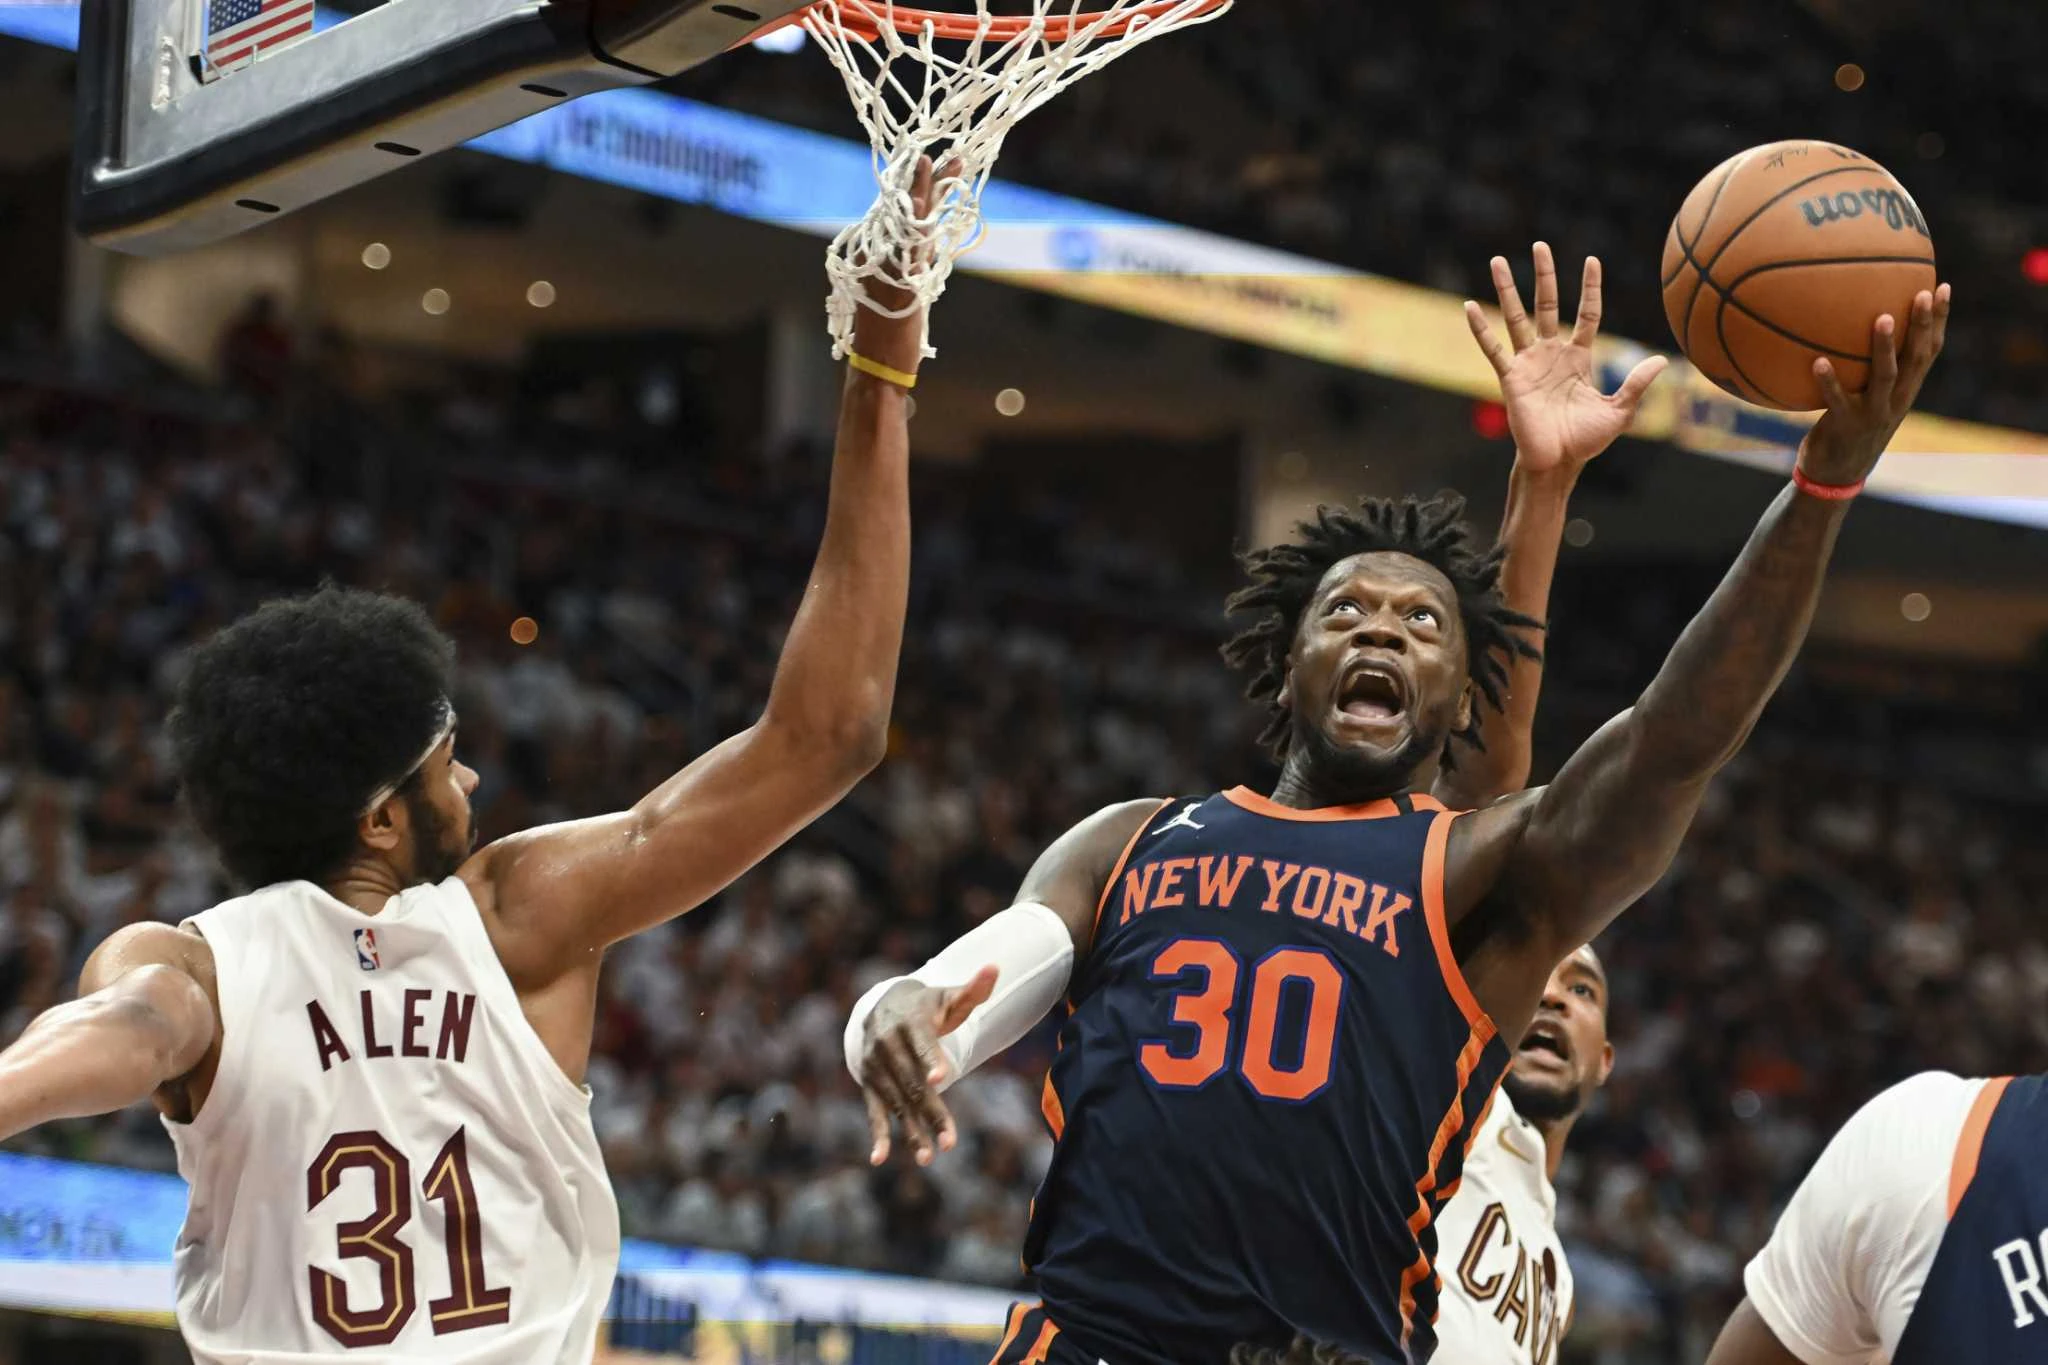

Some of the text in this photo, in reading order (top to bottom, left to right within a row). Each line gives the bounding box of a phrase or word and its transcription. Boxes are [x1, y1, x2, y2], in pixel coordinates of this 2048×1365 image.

[1119, 855, 1413, 958] NEW YORK
[1137, 935, 1349, 1104] 30
[306, 1123, 511, 1349] 31
[1457, 1202, 1560, 1365] CAV
